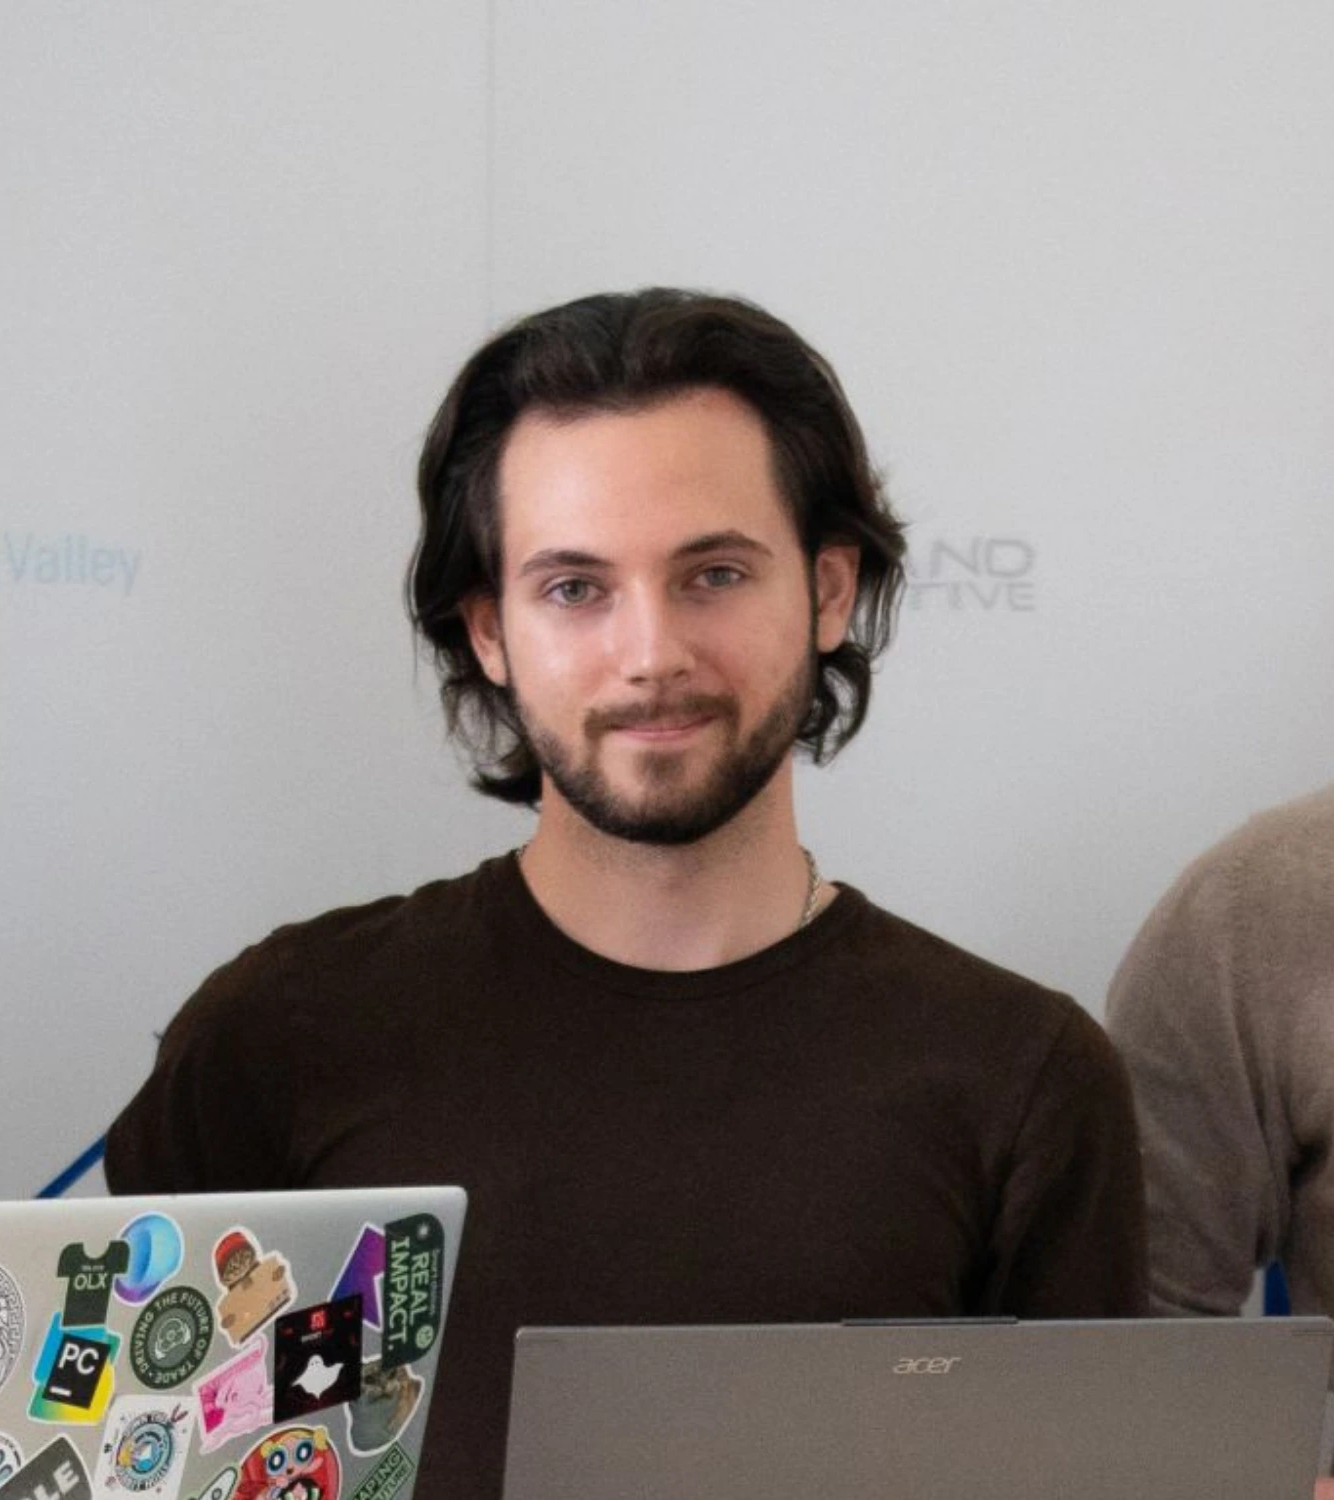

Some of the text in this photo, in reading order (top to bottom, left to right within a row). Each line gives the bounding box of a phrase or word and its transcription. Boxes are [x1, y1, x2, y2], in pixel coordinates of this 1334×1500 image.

[2, 532, 141, 597] Valley
[910, 538, 1036, 579] ND
[74, 1271, 108, 1291] OLX
[387, 1236, 411, 1351] IMPACT.
[409, 1251, 430, 1326] REAL
[57, 1343, 100, 1375] PC
[892, 1356, 962, 1374] acer
